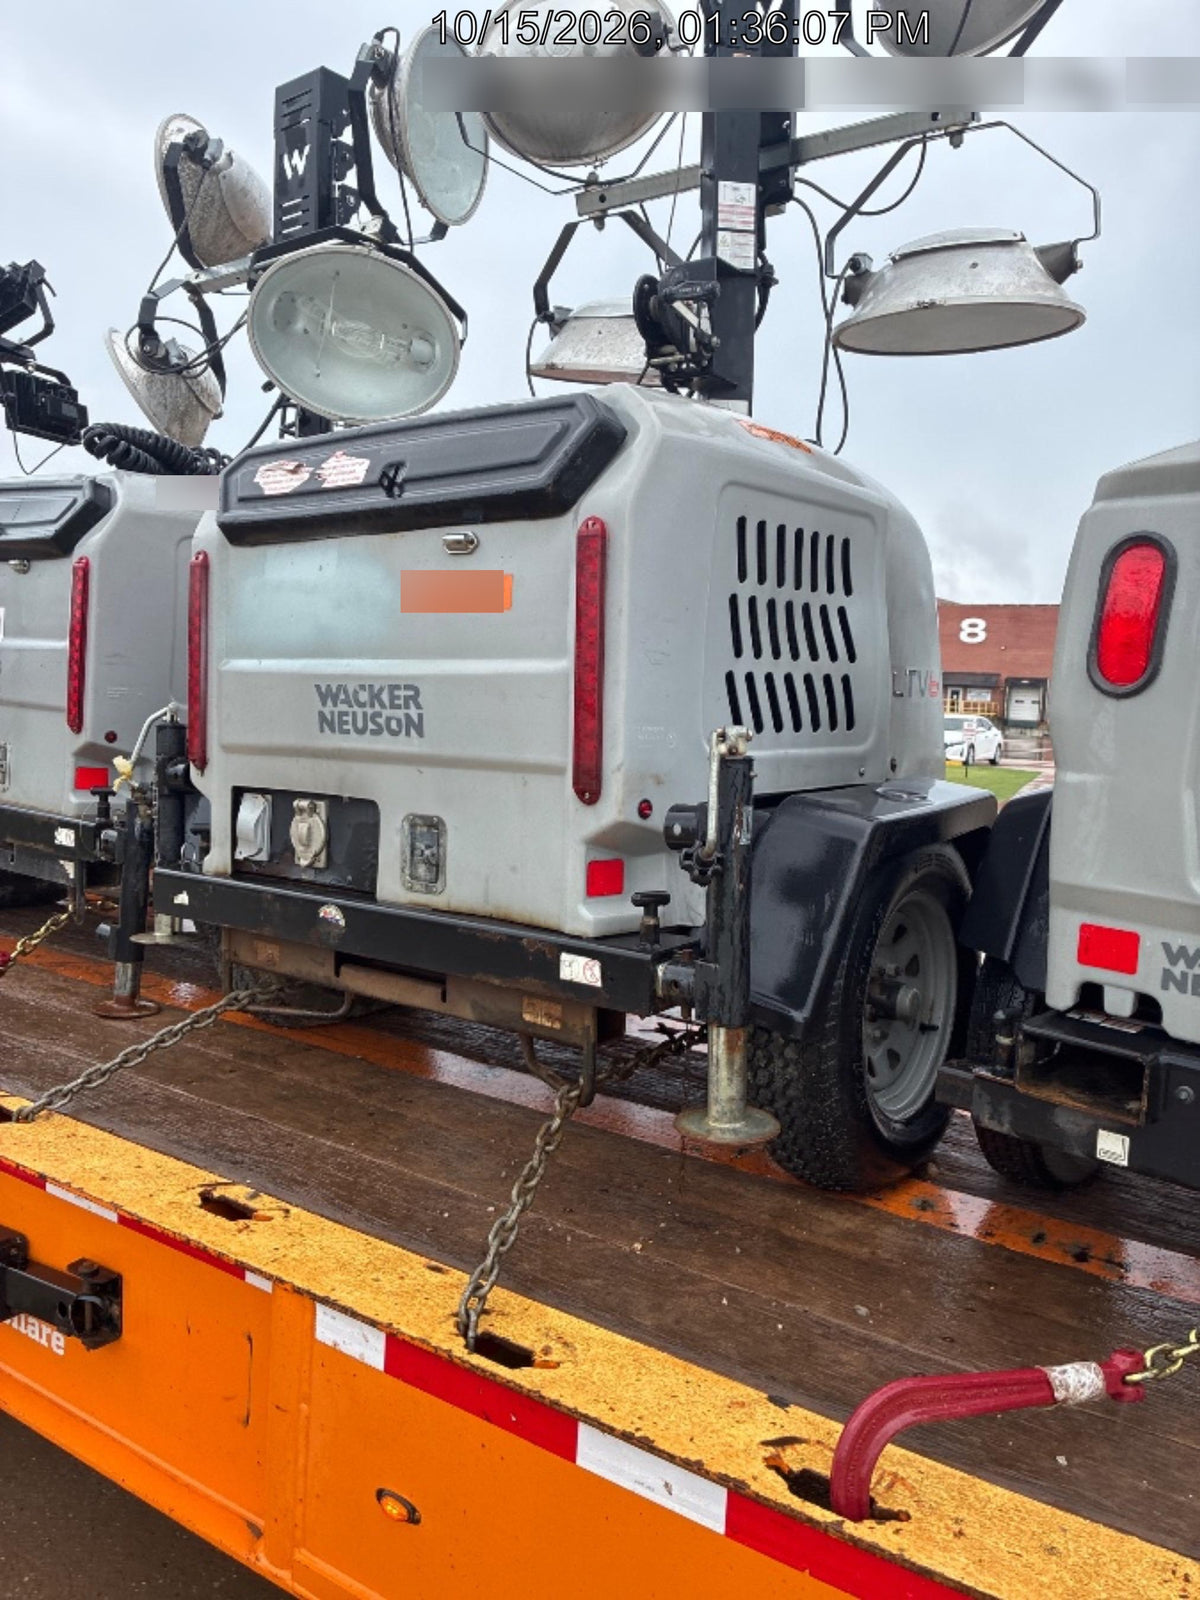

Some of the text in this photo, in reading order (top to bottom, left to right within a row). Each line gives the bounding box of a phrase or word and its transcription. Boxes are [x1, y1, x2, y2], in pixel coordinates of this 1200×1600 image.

[283, 144, 311, 180] W
[959, 617, 987, 644] 8
[314, 684, 424, 710] WACKER
[318, 711, 424, 738] NEUSON
